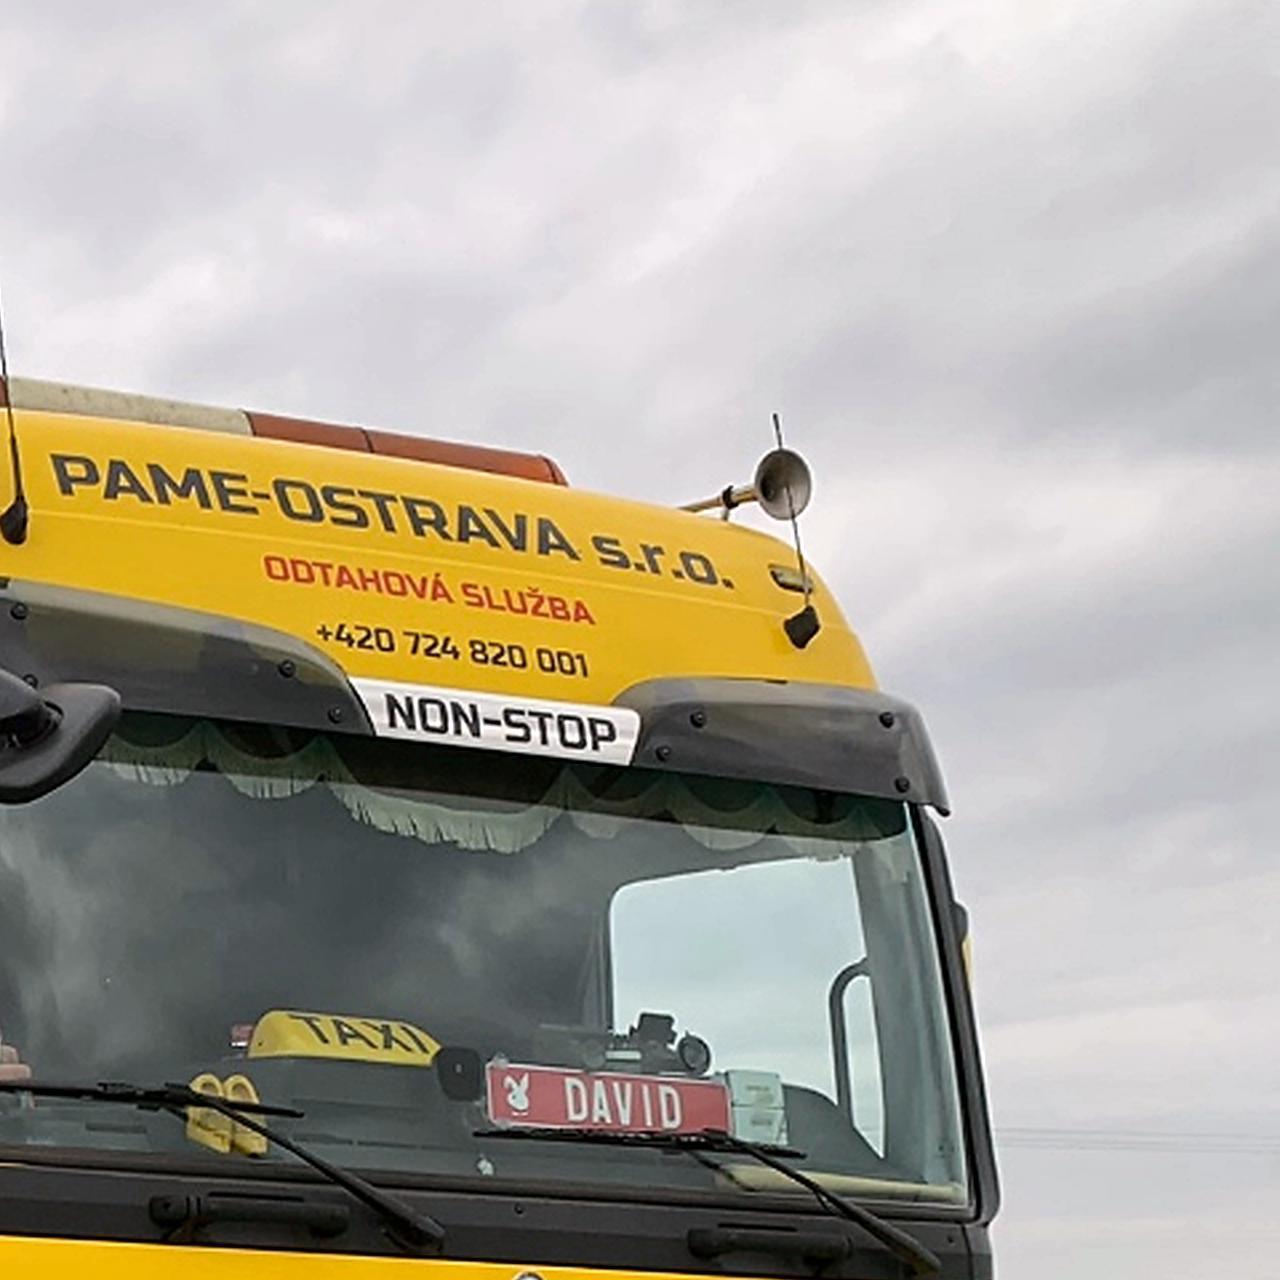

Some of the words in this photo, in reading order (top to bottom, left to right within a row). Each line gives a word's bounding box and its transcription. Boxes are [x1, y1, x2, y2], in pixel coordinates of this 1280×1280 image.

[50, 453, 581, 562] PAME-OSTRAVA
[592, 536, 734, 589] s.r.o.
[263, 555, 454, 604] ODTAHOVÁ
[461, 583, 596, 625] SLUŽBA
[317, 624, 395, 653] +420
[403, 632, 460, 660] 724
[470, 640, 527, 668] 820
[536, 649, 589, 677] 001
[385, 694, 616, 752] NON-STOP
[288, 1013, 431, 1055] TAXI
[563, 1076, 683, 1129] DAVID
